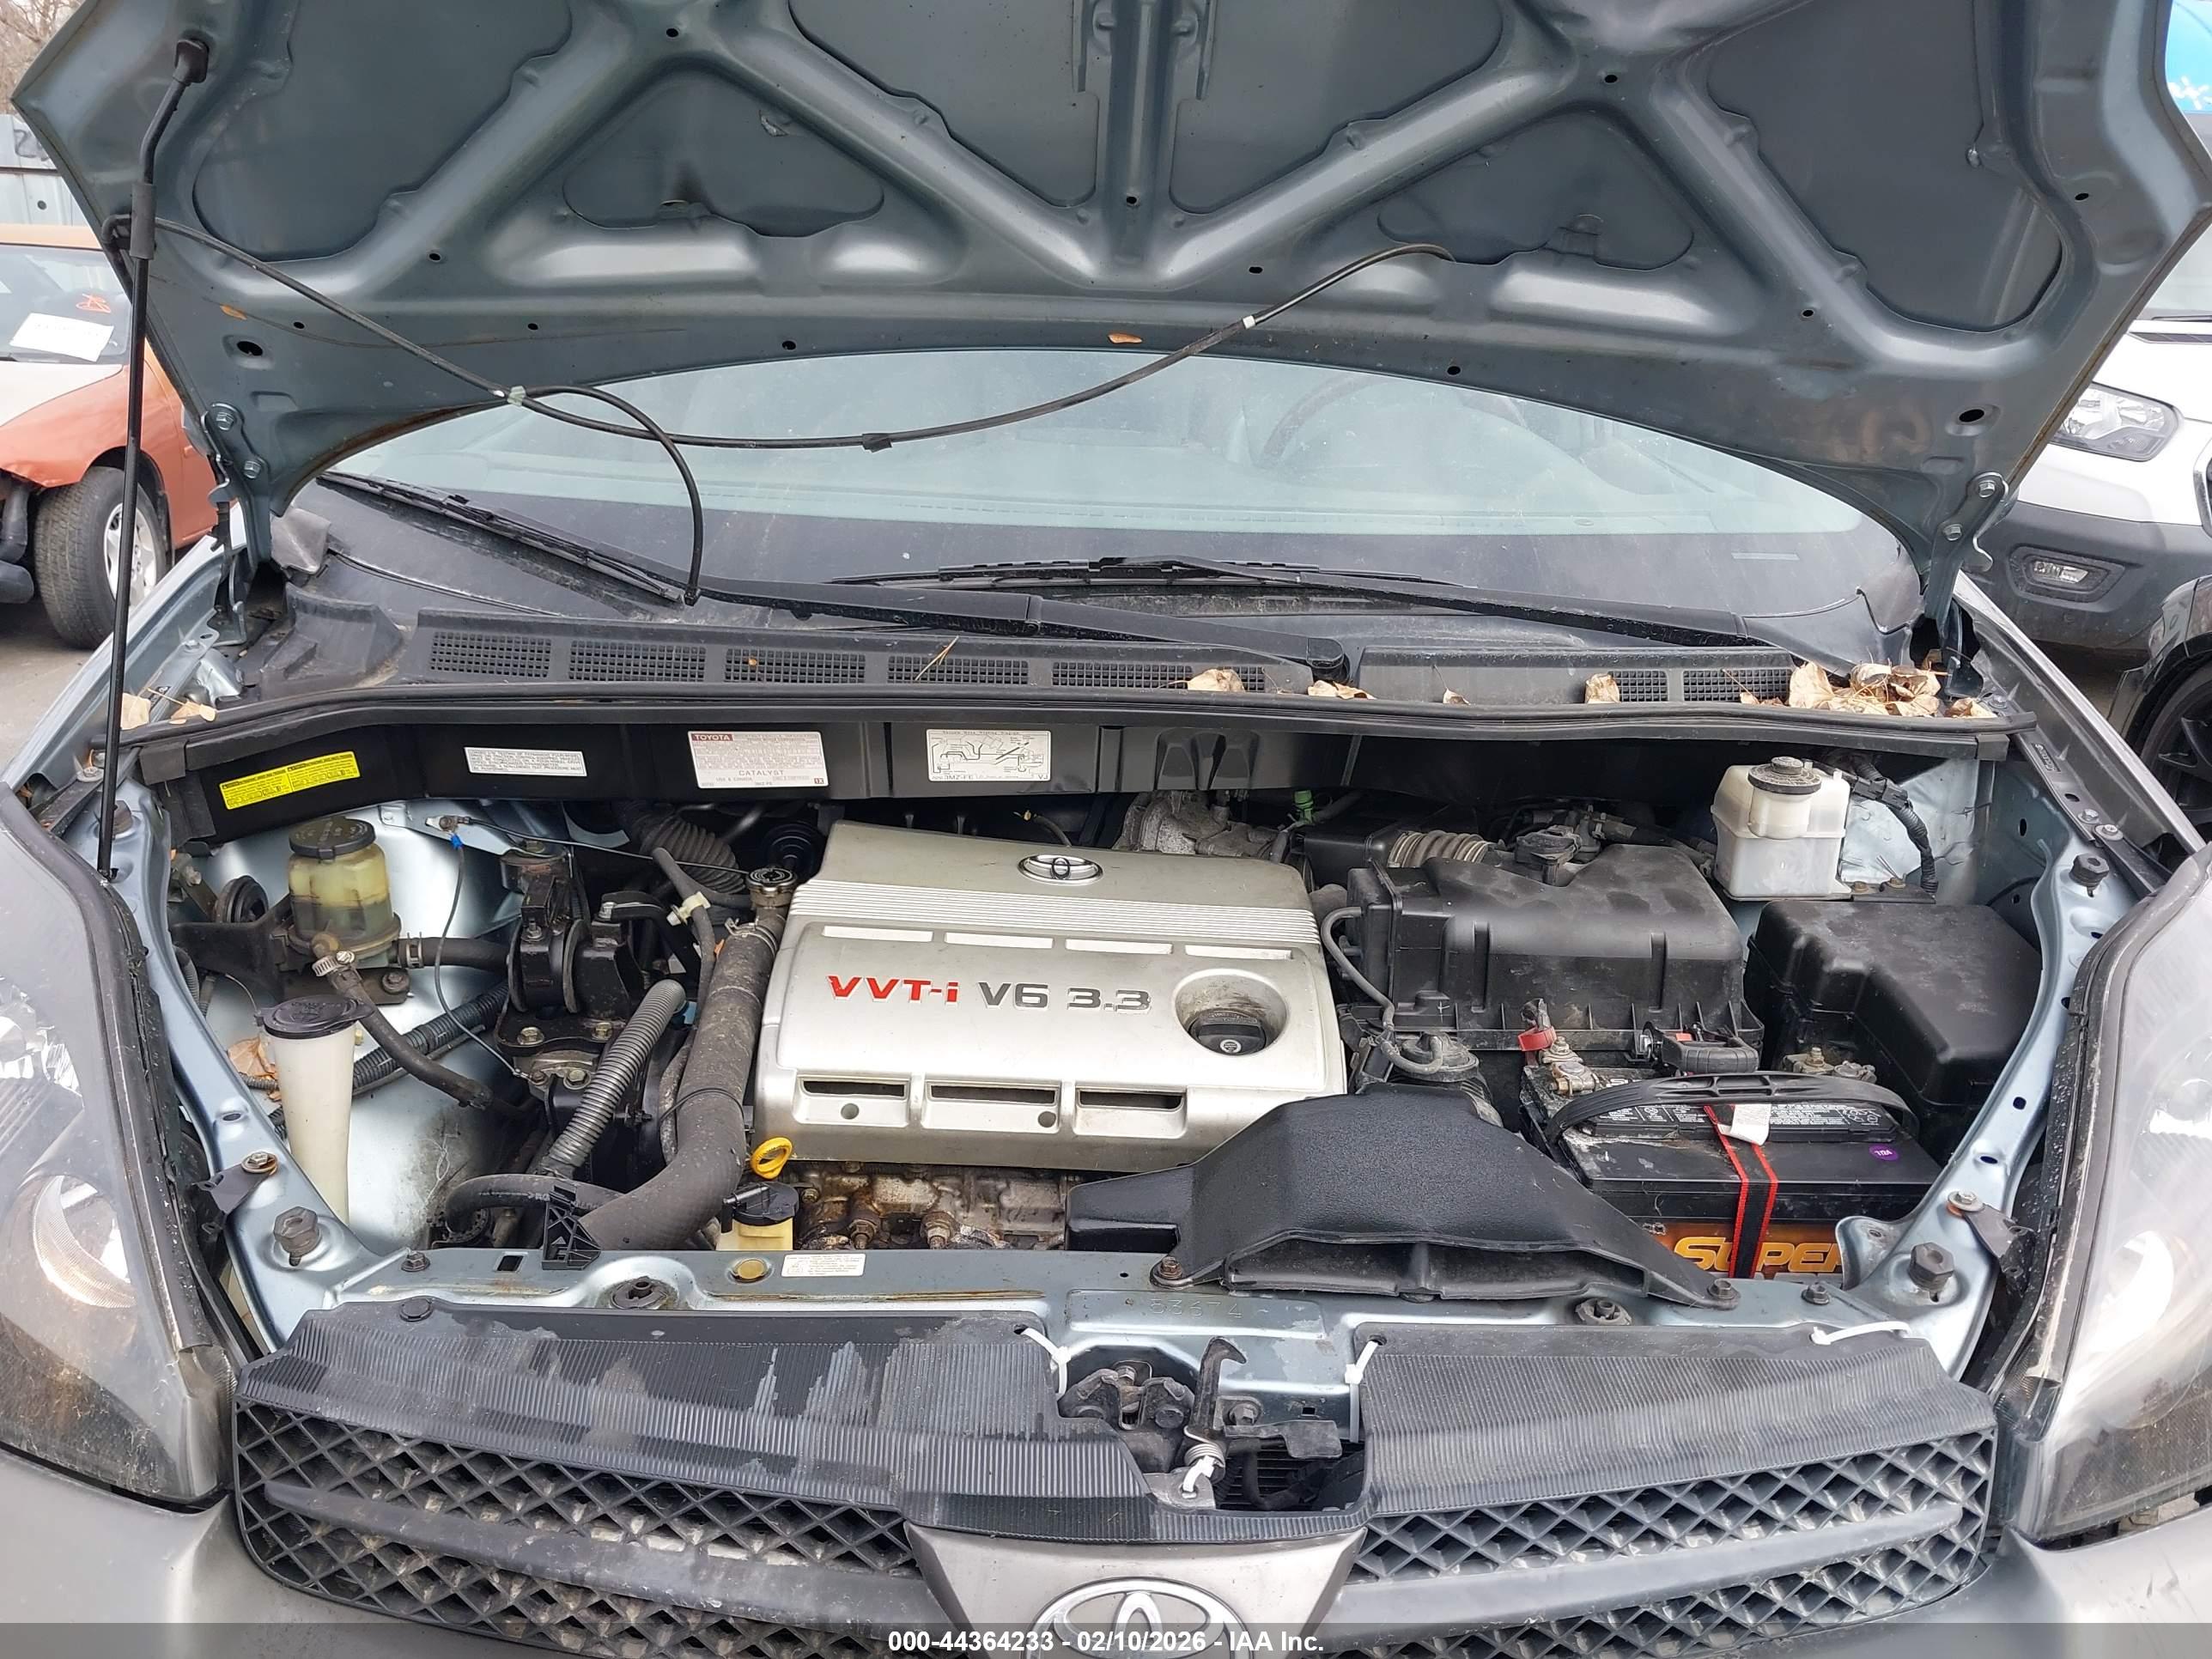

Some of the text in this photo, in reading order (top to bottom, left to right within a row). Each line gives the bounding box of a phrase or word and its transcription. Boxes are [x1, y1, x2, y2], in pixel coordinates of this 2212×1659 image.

[828, 975, 1152, 1012] VVT-i V6 3.3
